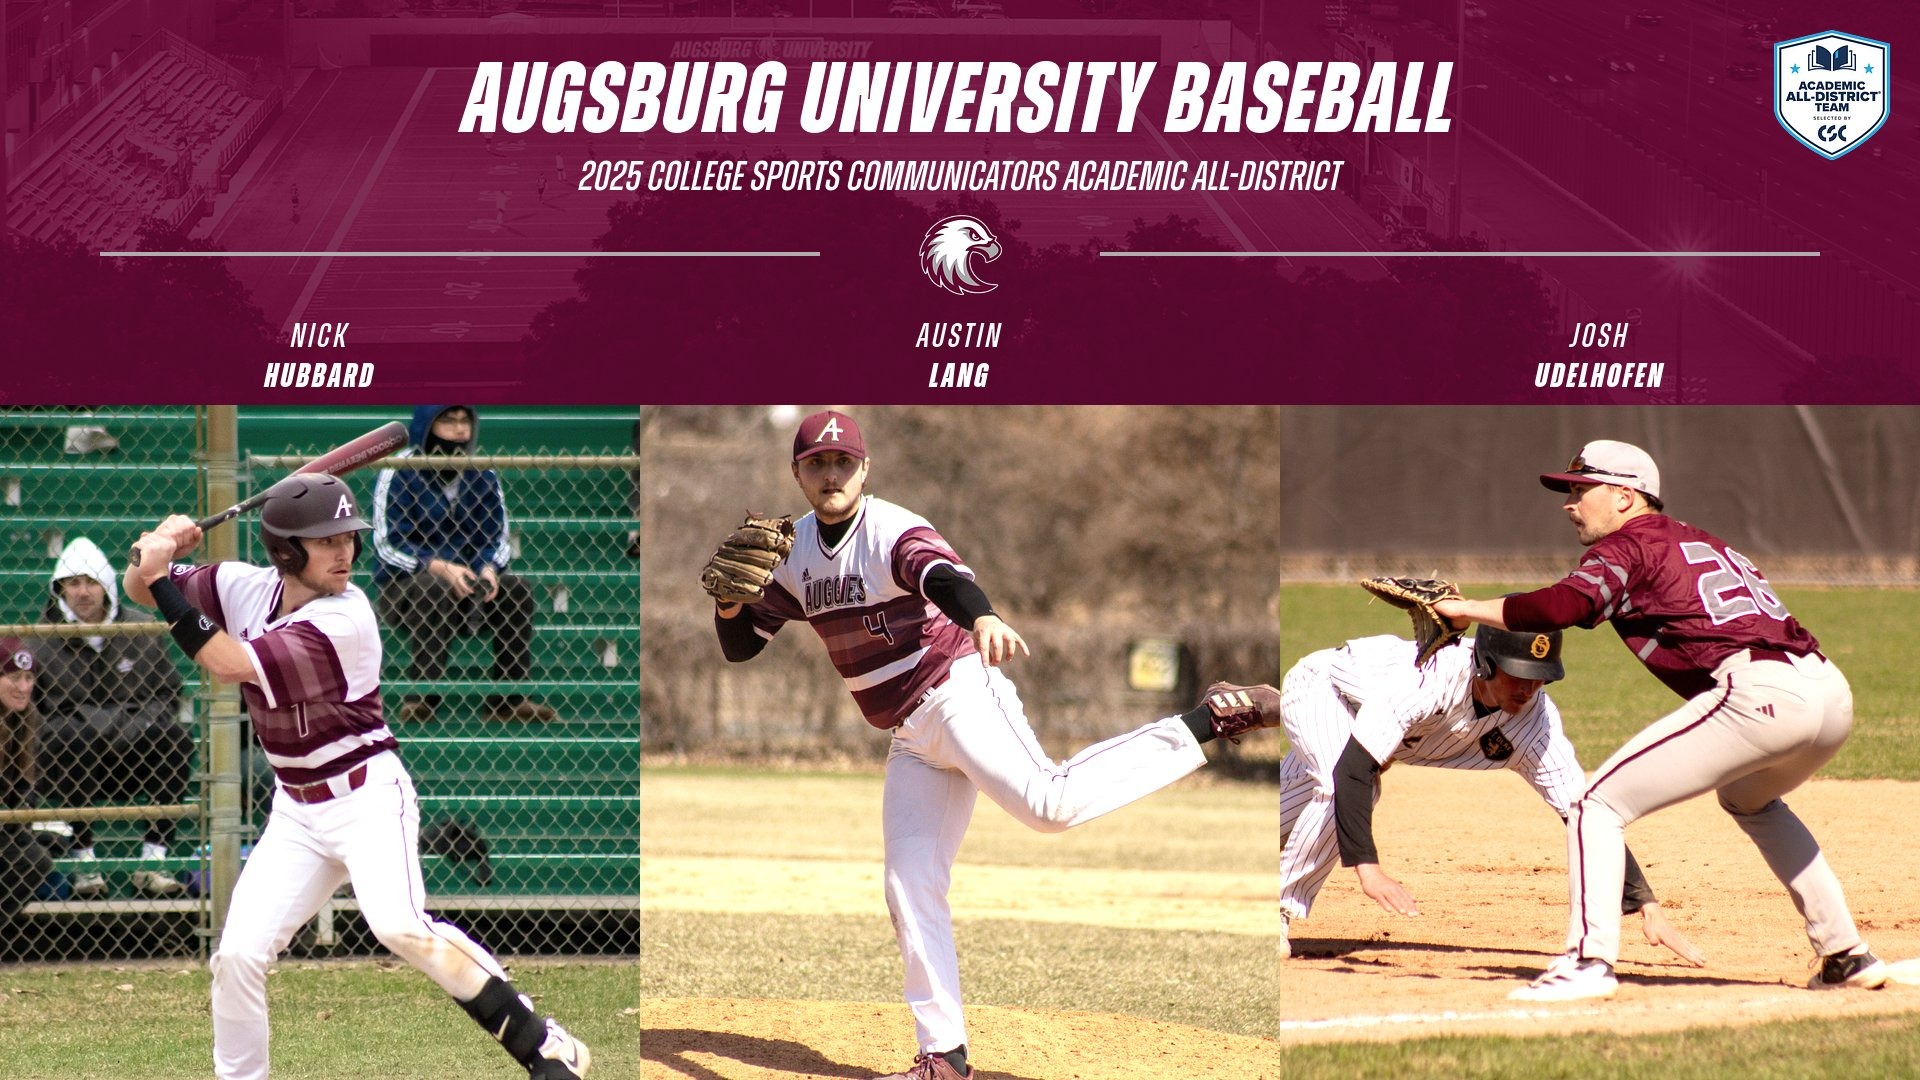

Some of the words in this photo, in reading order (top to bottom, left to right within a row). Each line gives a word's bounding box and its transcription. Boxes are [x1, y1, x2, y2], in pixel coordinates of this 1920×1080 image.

[814, 417, 844, 443] A
[333, 494, 353, 520] A
[804, 574, 867, 614] AUGGIES
[1679, 541, 1792, 626] 26
[862, 610, 895, 646] 4
